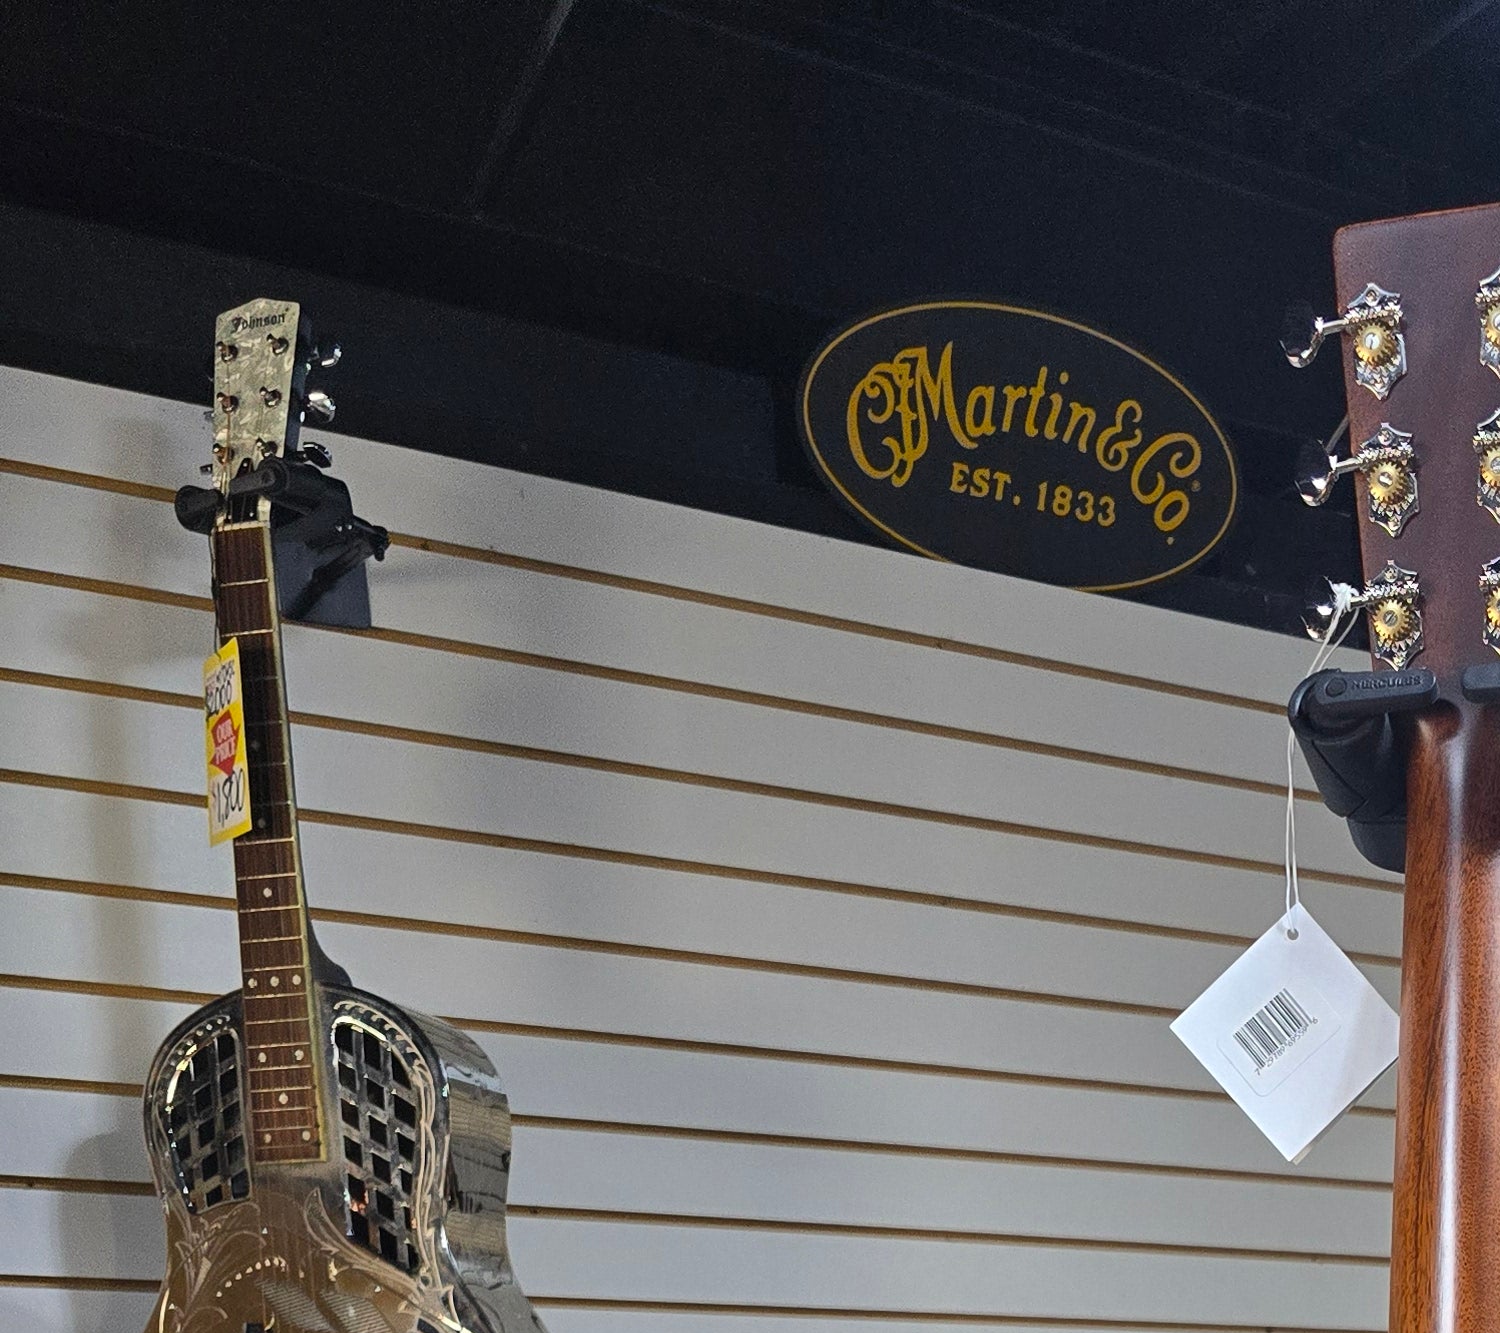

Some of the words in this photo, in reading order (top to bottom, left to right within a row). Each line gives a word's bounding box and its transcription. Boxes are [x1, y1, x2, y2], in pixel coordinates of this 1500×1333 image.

[231, 314, 286, 334] Johnson
[949, 462, 1020, 505] EST.
[1036, 481, 1115, 527] 1833
